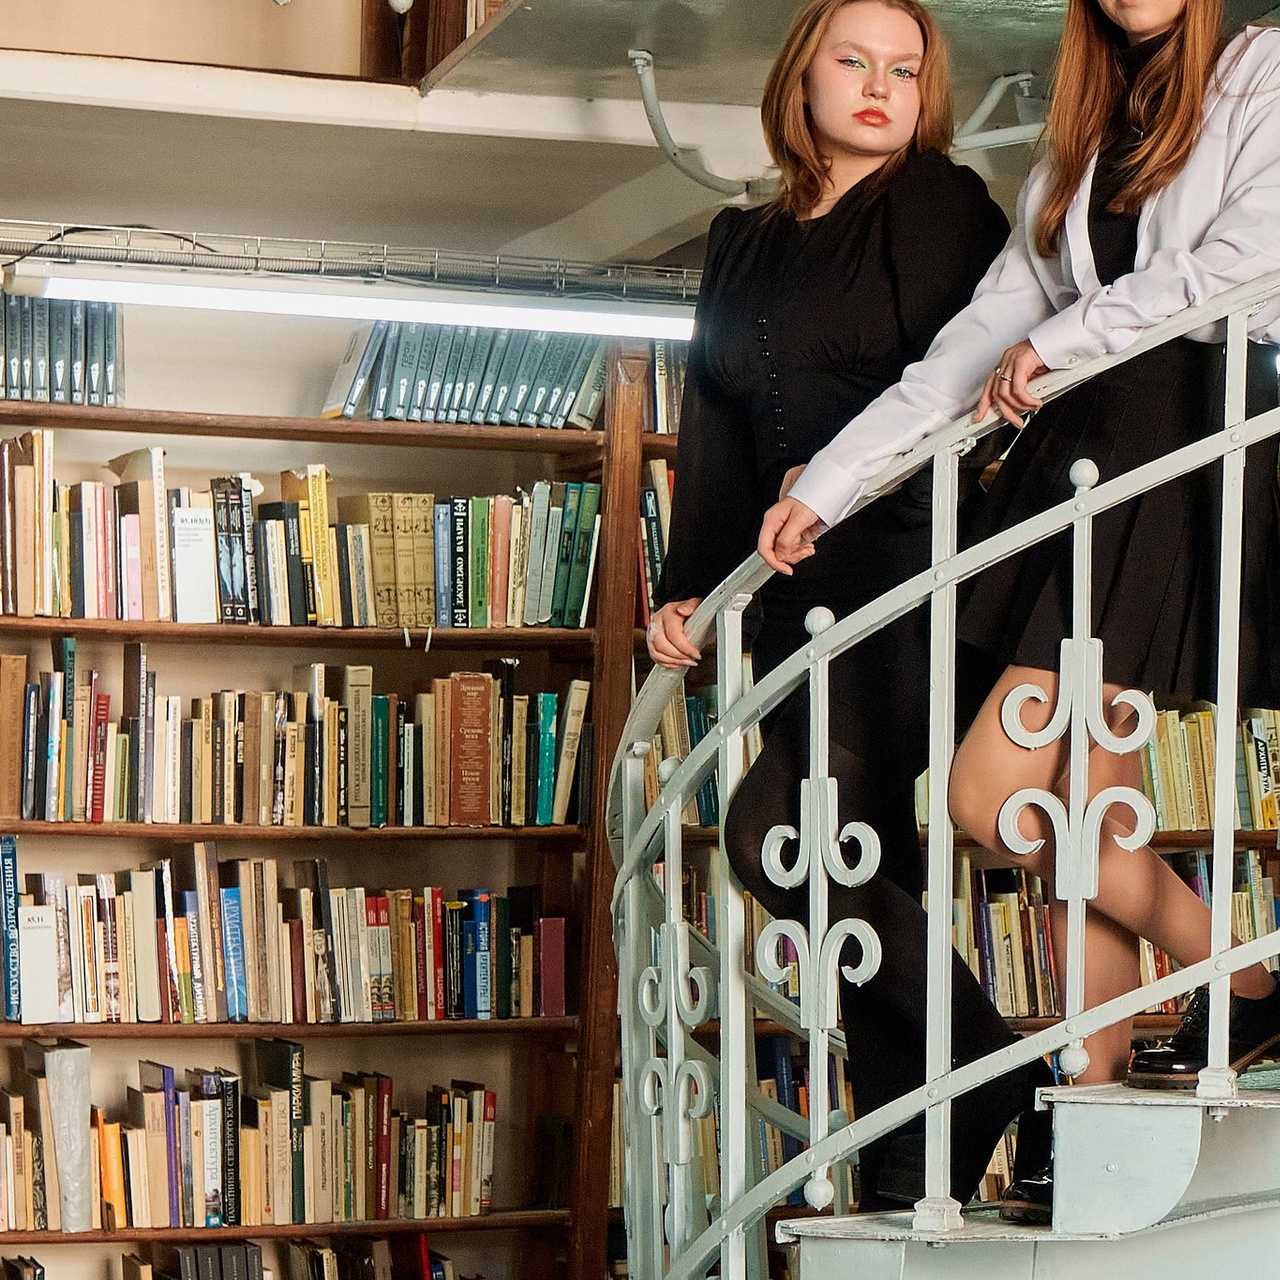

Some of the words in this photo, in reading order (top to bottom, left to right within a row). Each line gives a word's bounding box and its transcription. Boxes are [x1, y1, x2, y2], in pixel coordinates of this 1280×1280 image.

[156, 460, 165, 523] ИСКУССТВО
[157, 529, 166, 591] ЭТРУССКОЕ
[454, 518, 464, 552] ВАЗАРИ
[453, 557, 465, 607] ДЖОРДЖО
[1252, 736, 1272, 796] АРХИТЕКТУРА
[4, 858, 17, 938] ВОЗРОЖДЕНИЯ
[188, 912, 203, 974] АРХИТЕКТУРНЫЙ
[224, 898, 243, 980] АРХИТЕКТУРА
[480, 921, 489, 950] ИСТОРИЯ
[8, 943, 20, 1004] ИСКУССТВО
[480, 954, 489, 998] АРХИТЕКТУРЫ
[291, 1051, 302, 1082] МИРА
[225, 1081, 233, 1118] КАВКАЗА
[292, 1084, 302, 1119] ПАРКИ
[207, 1105, 219, 1180] Архитектура
[226, 1120, 235, 1167] СЕВЕРНОГО
[276, 1102, 288, 1176] ЗОДЧЕСТВО
[227, 1168, 236, 1222] ПАМЯТНИКИ
